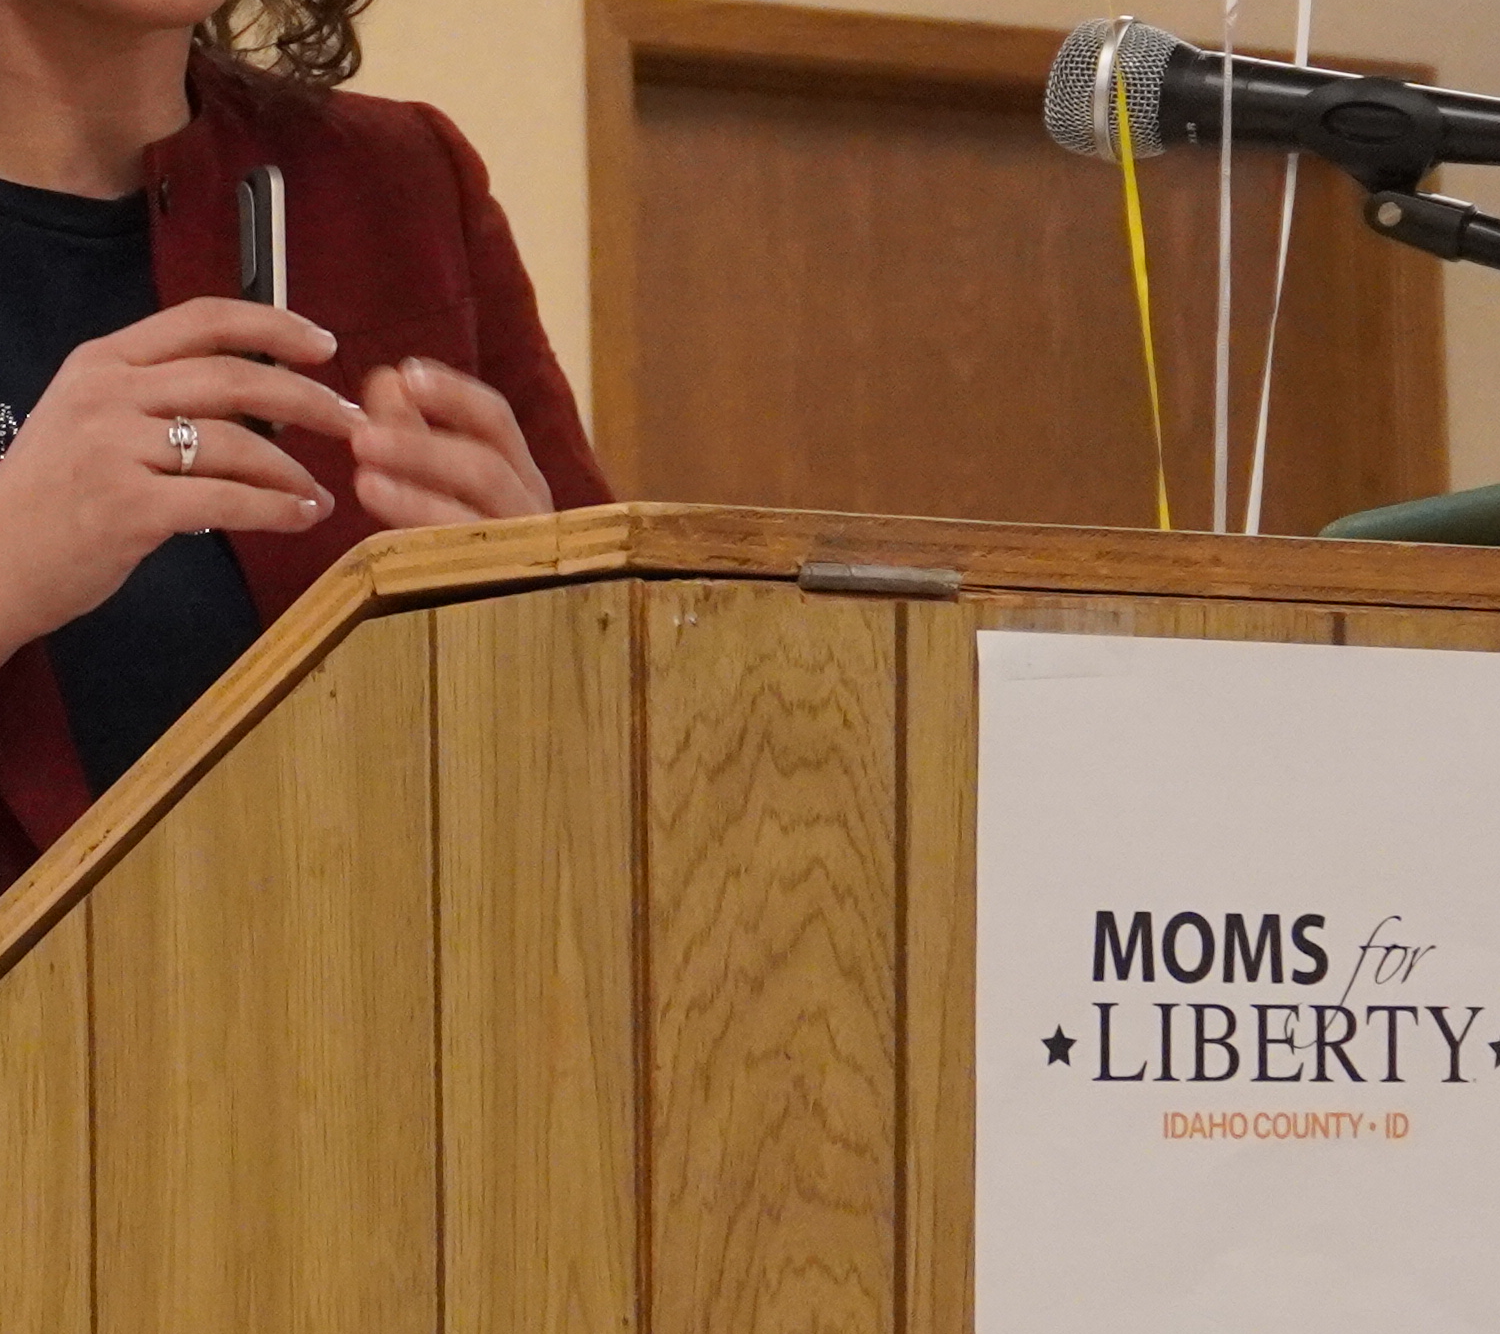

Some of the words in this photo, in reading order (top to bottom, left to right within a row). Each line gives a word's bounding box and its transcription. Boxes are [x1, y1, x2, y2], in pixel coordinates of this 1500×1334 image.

[1092, 910, 1330, 985] MOMS
[1284, 915, 1437, 1055] for
[1091, 1002, 1486, 1083] LIBERTY
[1163, 1112, 1249, 1139] IDAHO
[1252, 1112, 1364, 1139] COUNTY
[1385, 1112, 1411, 1139] ID
